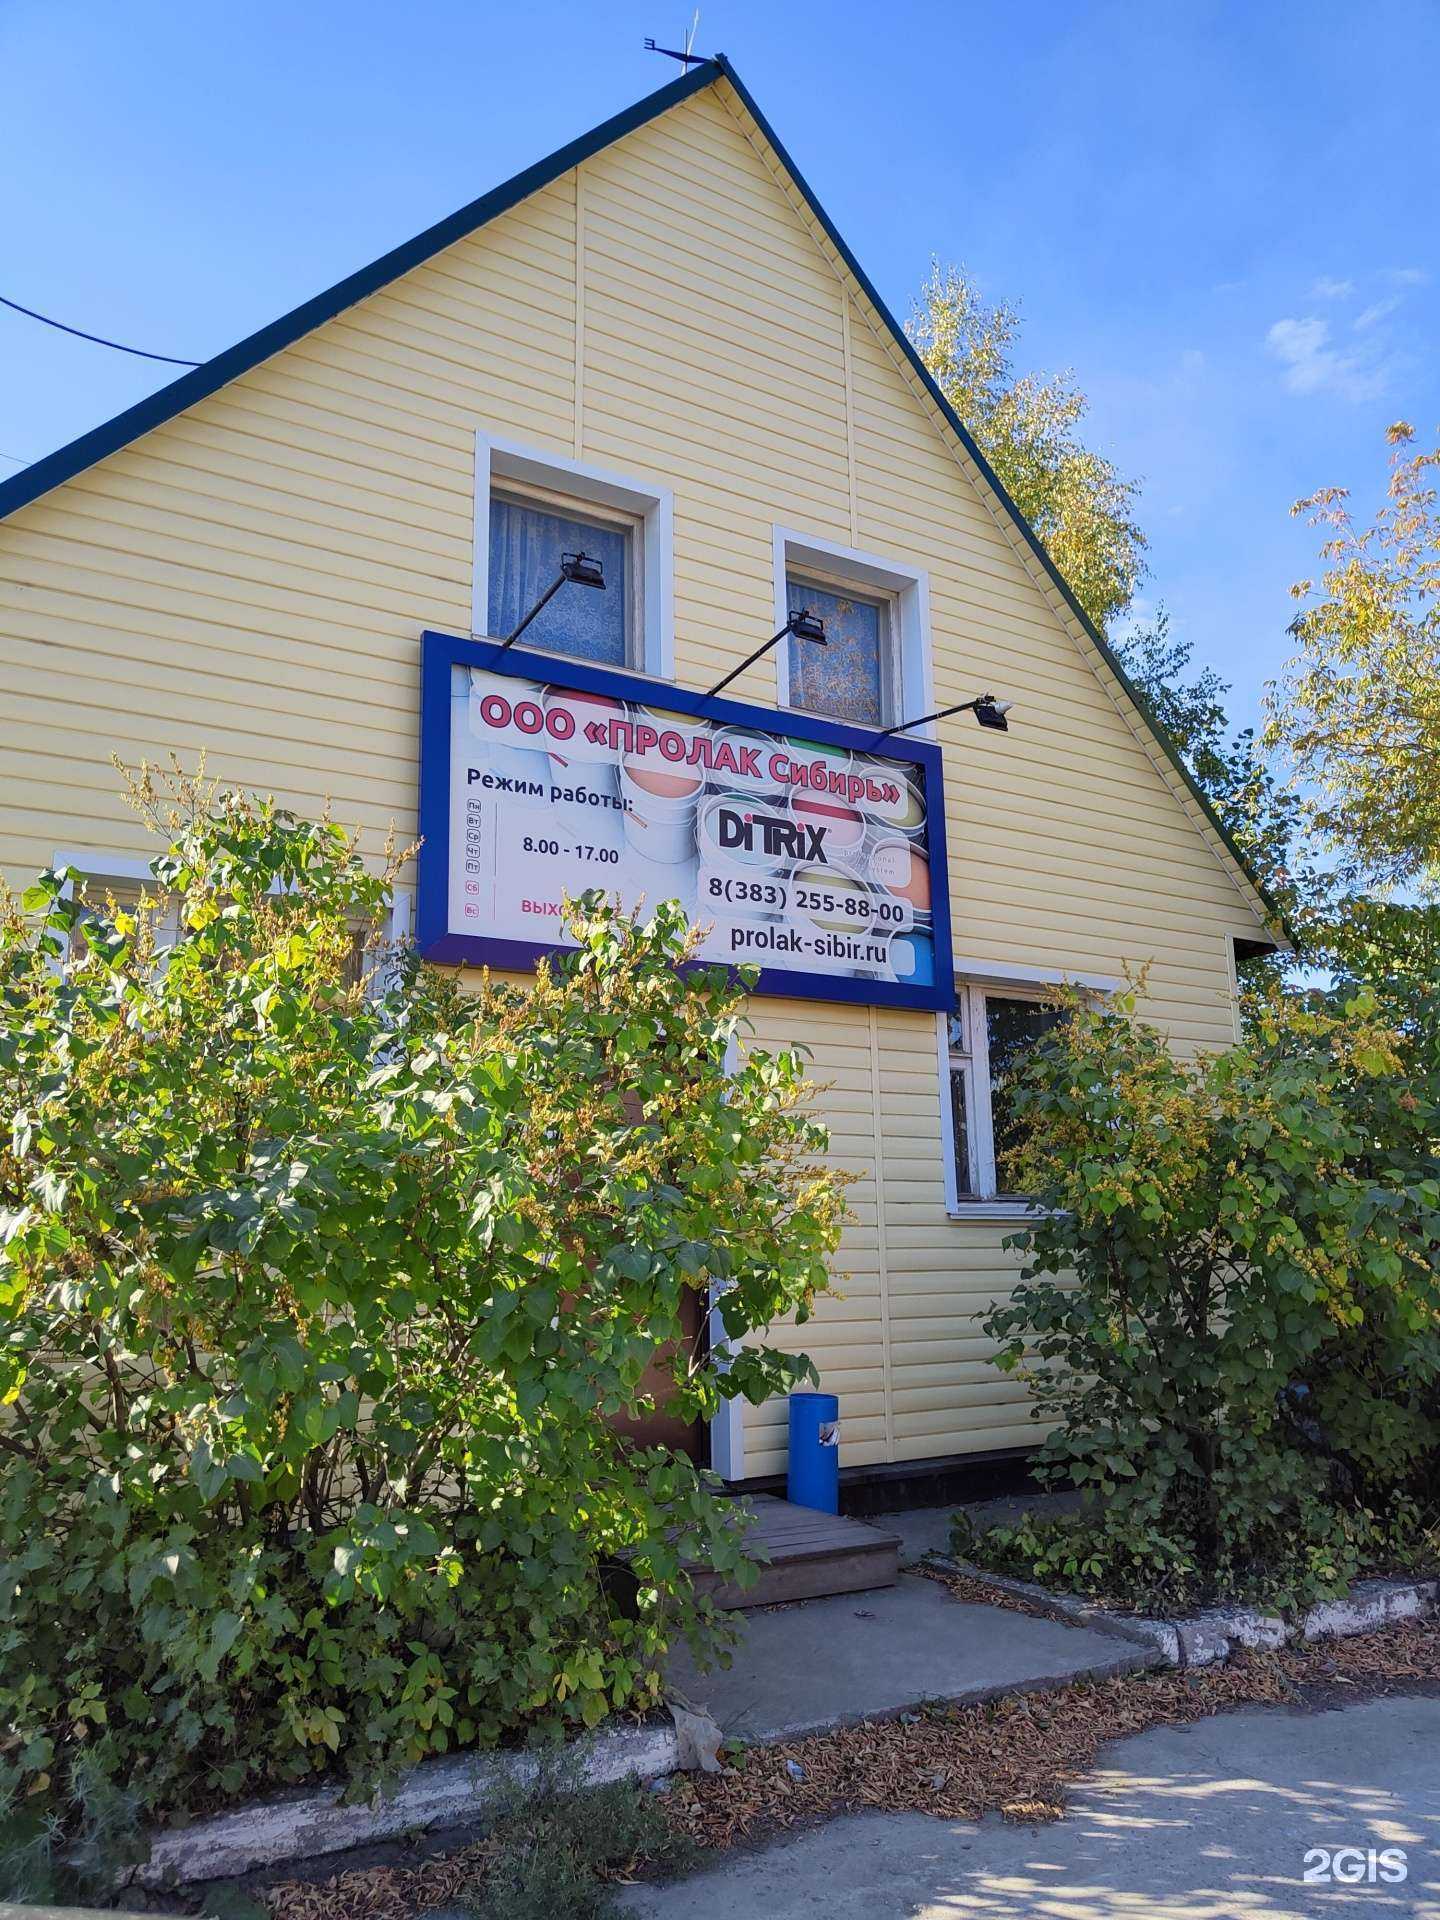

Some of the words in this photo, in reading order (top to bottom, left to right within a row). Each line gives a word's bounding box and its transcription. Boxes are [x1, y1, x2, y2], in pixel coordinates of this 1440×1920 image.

[480, 694, 576, 741] ООО
[583, 718, 763, 778] «ПРОЛАК
[768, 752, 900, 804] Сибирь»
[467, 768, 544, 797] Режим
[550, 785, 633, 812] работы:
[523, 837, 559, 856] 8.00
[575, 845, 619, 864] 17.00
[719, 808, 828, 864] DiTRiX
[708, 877, 787, 910] 8(383)
[795, 890, 905, 923] 255-88-00
[731, 926, 888, 964] prolak-sibir.ru
